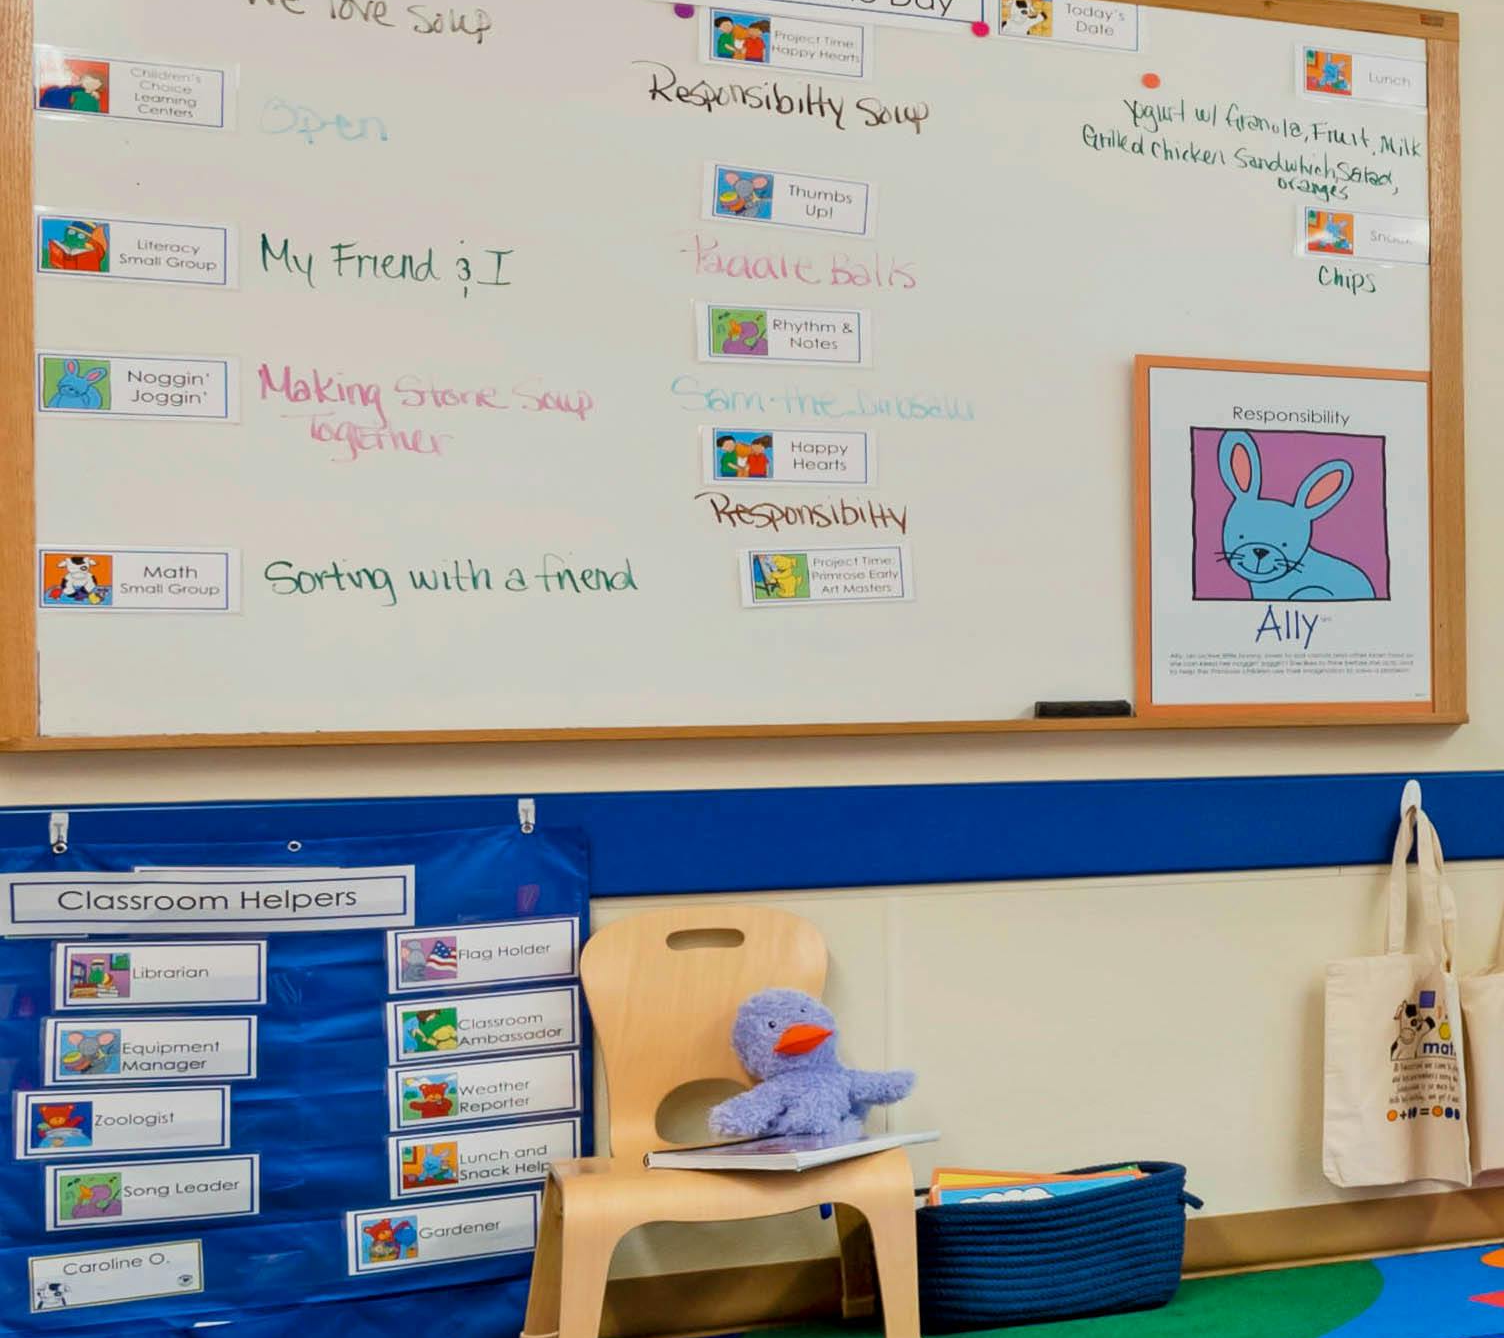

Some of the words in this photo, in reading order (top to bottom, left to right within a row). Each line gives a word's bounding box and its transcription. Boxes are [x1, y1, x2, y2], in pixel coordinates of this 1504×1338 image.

[1064, 2, 1126, 24] Today's
[1075, 20, 1115, 37] Date
[771, 44, 815, 60] Happy
[139, 80, 193, 95] Choice
[134, 92, 197, 108] Learning
[137, 104, 194, 118] Centers
[1381, 134, 1422, 157] Milk
[789, 184, 852, 204] Thumbs
[806, 204, 833, 220] Up!
[136, 238, 201, 258] Literacy
[118, 251, 162, 268] Small
[166, 256, 218, 276] Group
[260, 233, 315, 288] My
[331, 242, 438, 283] Friend
[477, 249, 514, 286] I
[773, 318, 837, 337] Rhythm
[842, 322, 853, 334] &
[790, 337, 838, 351] Notes
[126, 369, 211, 388] Noggin'
[130, 388, 208, 408] Joggin'
[257, 363, 382, 414] Making
[1232, 405, 1350, 428] Responsibility
[791, 440, 848, 457] Happy
[793, 457, 847, 472] Hearts
[813, 556, 859, 569] Project
[143, 565, 198, 580] Math
[263, 559, 397, 607] Sorting
[410, 562, 493, 594] with
[505, 571, 527, 592] a
[534, 553, 638, 592] friend
[812, 570, 866, 581] Primrose
[869, 569, 898, 580] Early
[120, 581, 166, 596] Small
[169, 582, 221, 599] Group
[822, 584, 839, 594] Art
[843, 583, 892, 593] Masters
[1255, 604, 1319, 650] Ally
[57, 888, 230, 913] Classroom
[241, 887, 357, 917] Helpers
[458, 946, 491, 964] Flag
[497, 941, 551, 959] Holder
[132, 964, 209, 981] Librarian
[458, 1012, 544, 1030] Classroom
[459, 1027, 563, 1046] Ambassador
[122, 1039, 220, 1057] Equipment
[122, 1056, 207, 1075] Manager
[459, 1079, 530, 1096] Weather
[459, 1095, 530, 1115] Reporter
[95, 1111, 175, 1129] Zoologist
[459, 1147, 510, 1165] Lunch
[514, 1144, 548, 1158] and
[459, 1164, 509, 1181] Snack
[123, 1182, 170, 1200] Song
[172, 1178, 240, 1195] Leader
[419, 1220, 500, 1241] Gardener
[62, 1255, 143, 1276] Caroline
